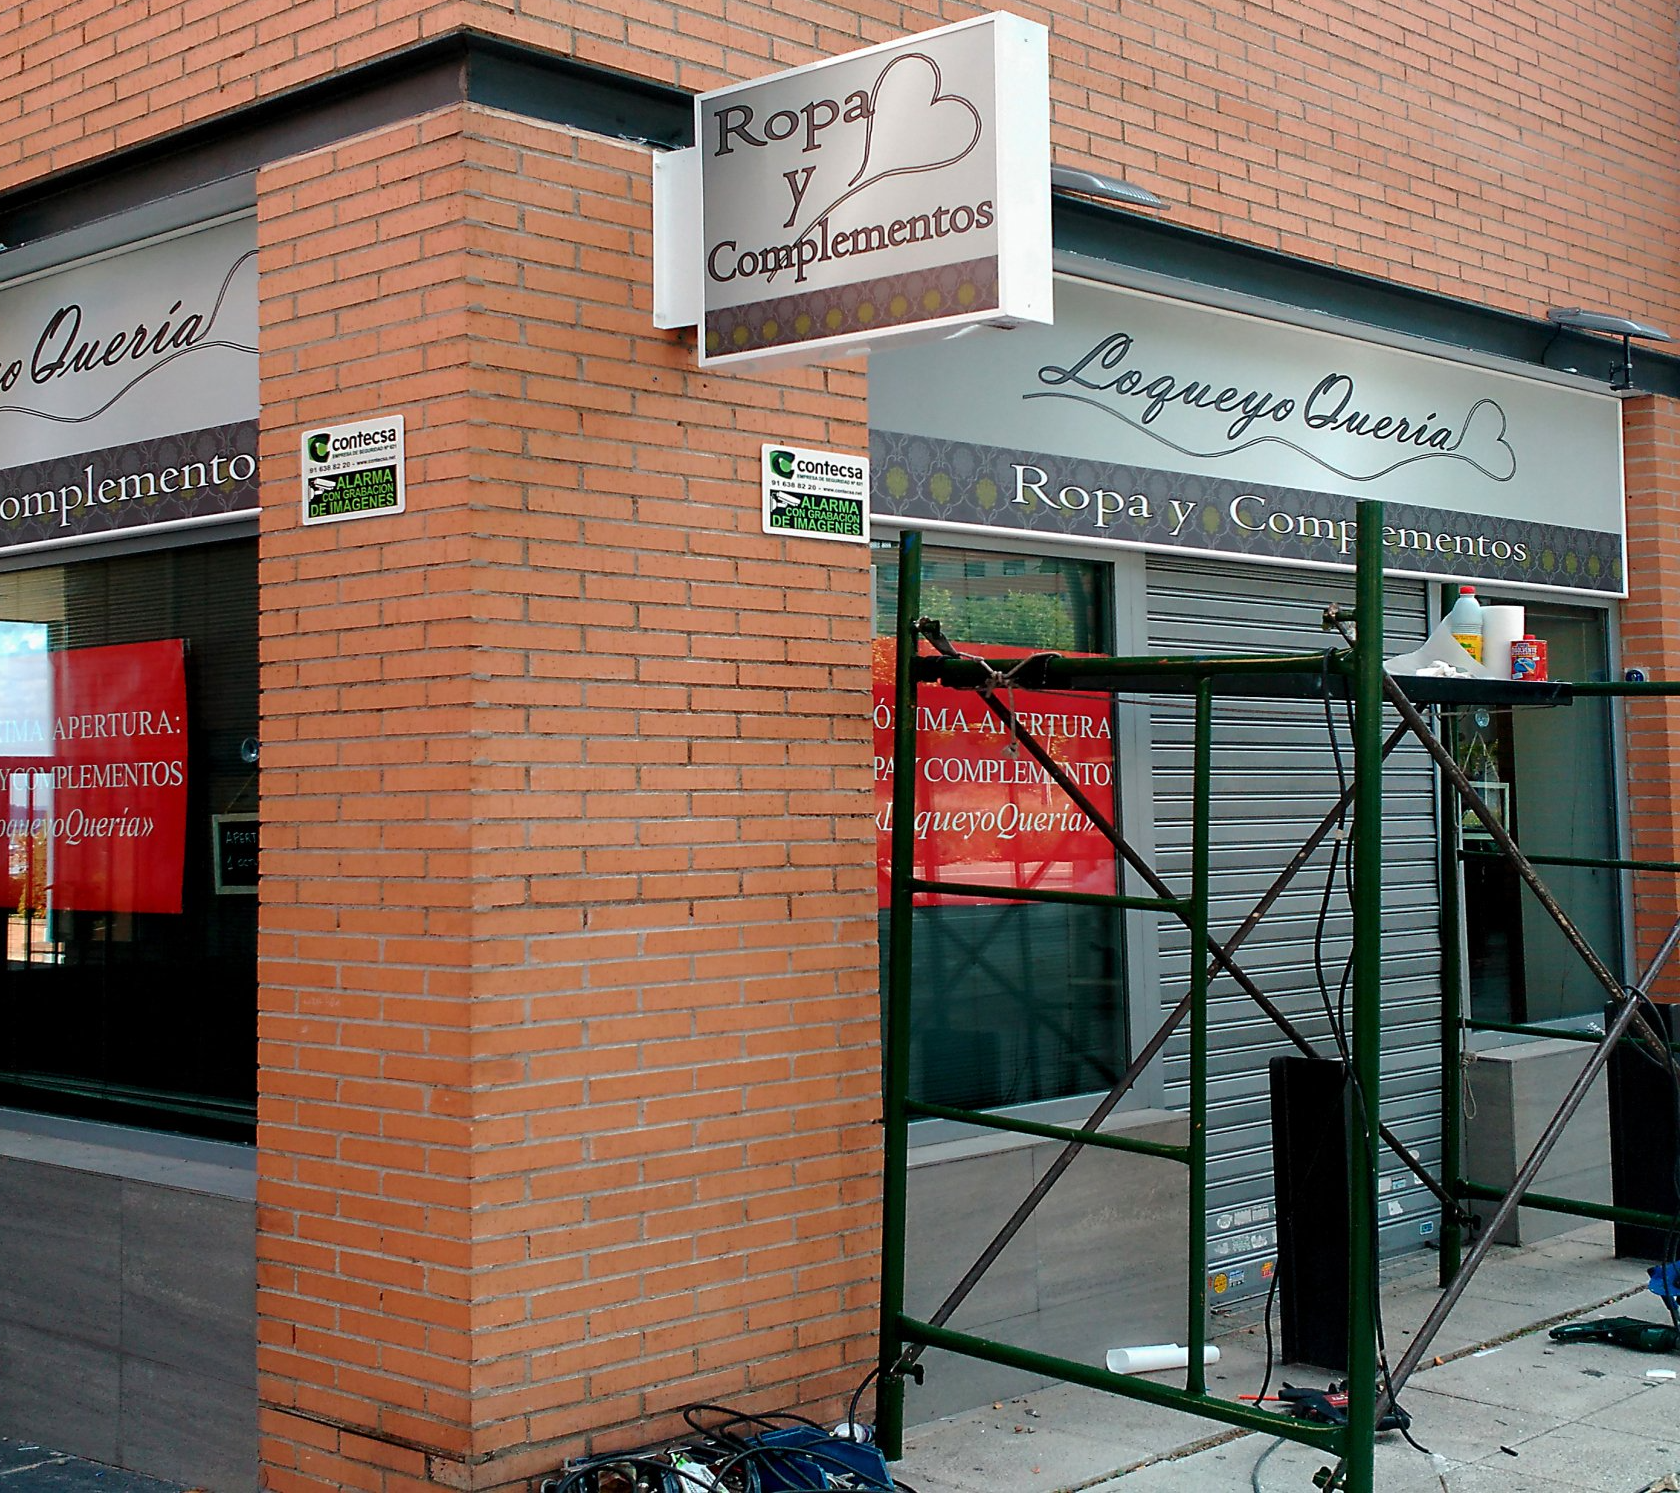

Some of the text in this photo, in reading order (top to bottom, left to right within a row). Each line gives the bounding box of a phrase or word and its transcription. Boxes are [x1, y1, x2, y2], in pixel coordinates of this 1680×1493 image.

[713, 89, 875, 157] Ropa
[782, 165, 816, 229] y
[707, 200, 995, 284] Complementos
[30, 300, 204, 383] Quería
[1038, 332, 1452, 450] Loqueyo Quería
[333, 429, 396, 451] contecsa
[342, 461, 351, 469] 20
[797, 460, 863, 480] contecsa
[336, 468, 393, 490] ALARMA
[310, 493, 395, 517] DE IMAGENES
[322, 491, 341, 503] CON
[801, 496, 859, 515] ALARMA
[772, 515, 861, 535] DE IMAGENES
[785, 507, 806, 518] CON
[1010, 464, 1528, 561] Ropa y Compementos
[52, 709, 181, 740] APERTURA:
[873, 697, 970, 733] ÓIMA
[924, 758, 1112, 786] COMPLEMNTO
